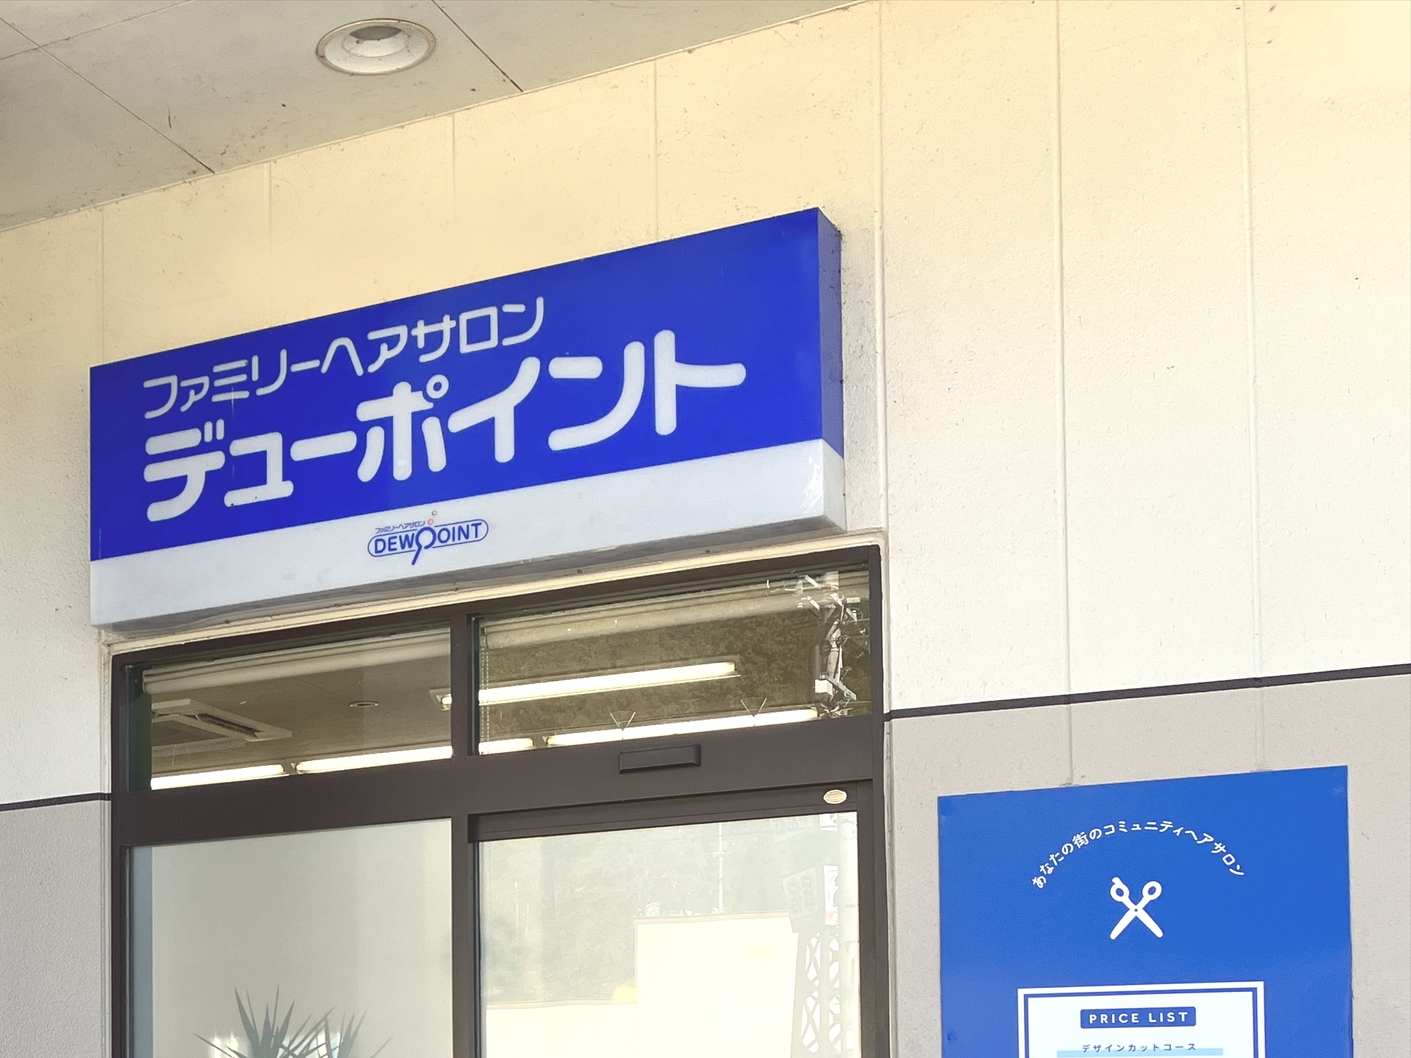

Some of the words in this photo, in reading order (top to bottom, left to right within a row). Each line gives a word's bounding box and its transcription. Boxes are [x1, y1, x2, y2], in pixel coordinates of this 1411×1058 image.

[143, 296, 545, 420] ファミリーヘアサロン
[143, 329, 747, 523] デューポイント
[1031, 820, 1245, 889] あなたの街のコミュニティヘアサロン
[1081, 1043, 1197, 1053] デザインカットコース
[1088, 1012, 1140, 1025] PRICE
[1148, 1011, 1189, 1023] LIST
